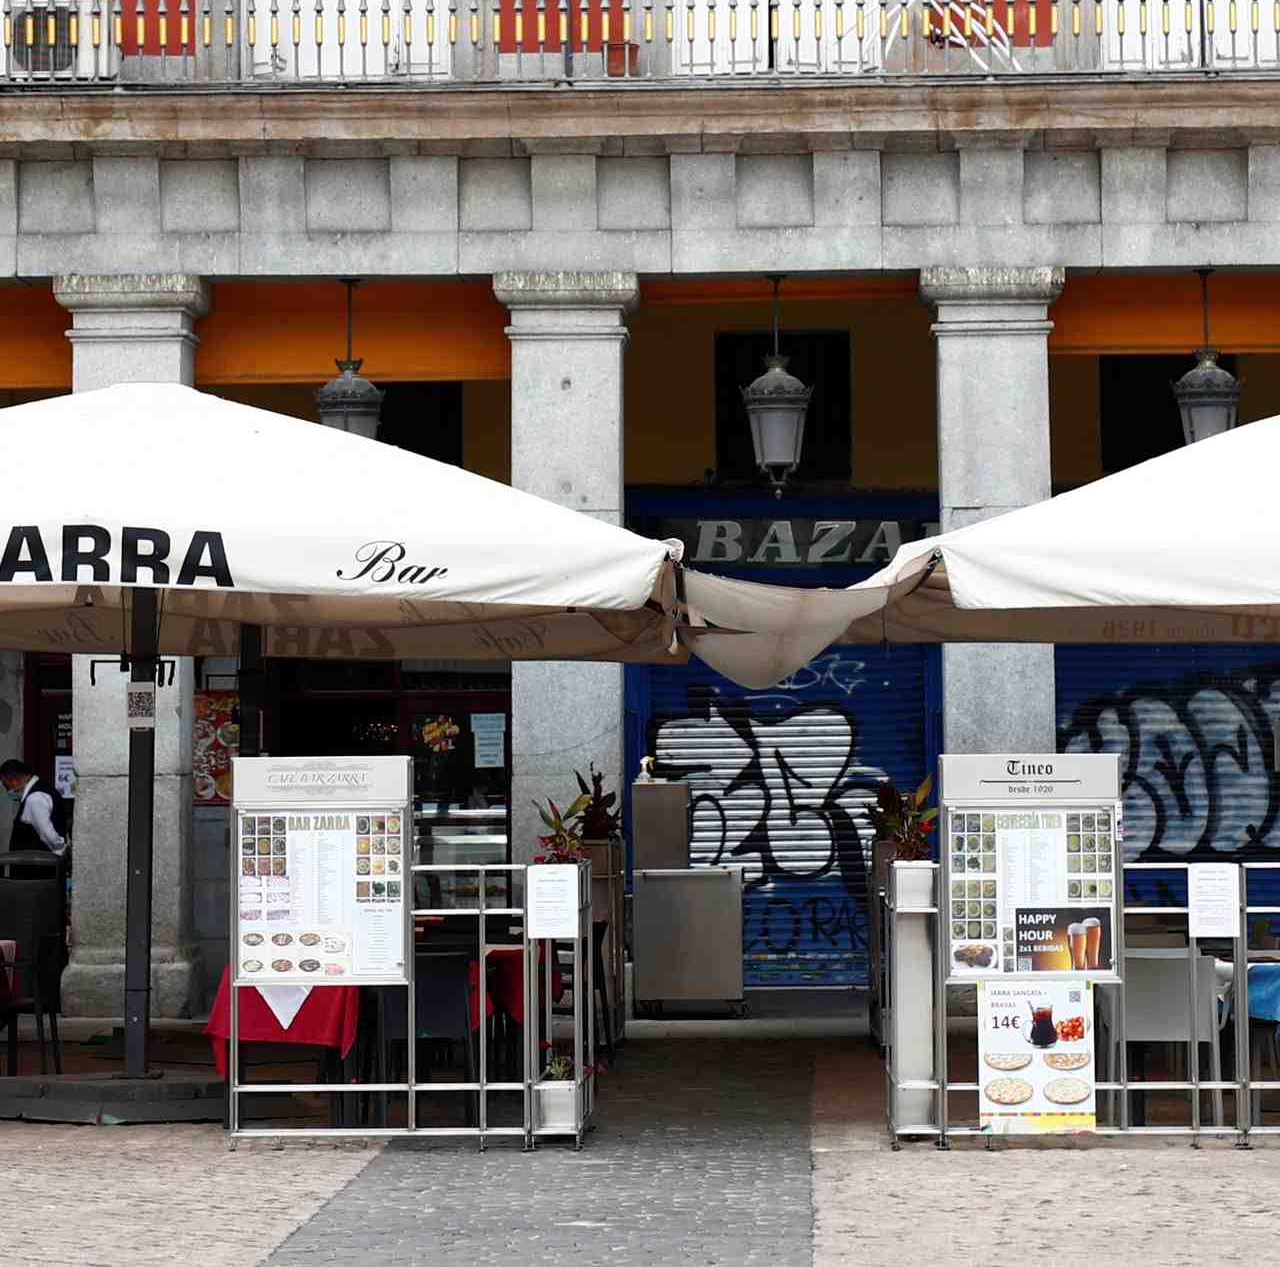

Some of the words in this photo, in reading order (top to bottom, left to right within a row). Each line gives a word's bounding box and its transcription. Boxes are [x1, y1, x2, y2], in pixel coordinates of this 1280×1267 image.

[689, 520, 940, 563] BAZA
[336, 540, 450, 585] Bar
[1007, 760, 1053, 775] Tineo
[1018, 914, 1057, 925] HAPPY
[1019, 930, 1054, 941] HOUR
[991, 1015, 1021, 1030] 14€
